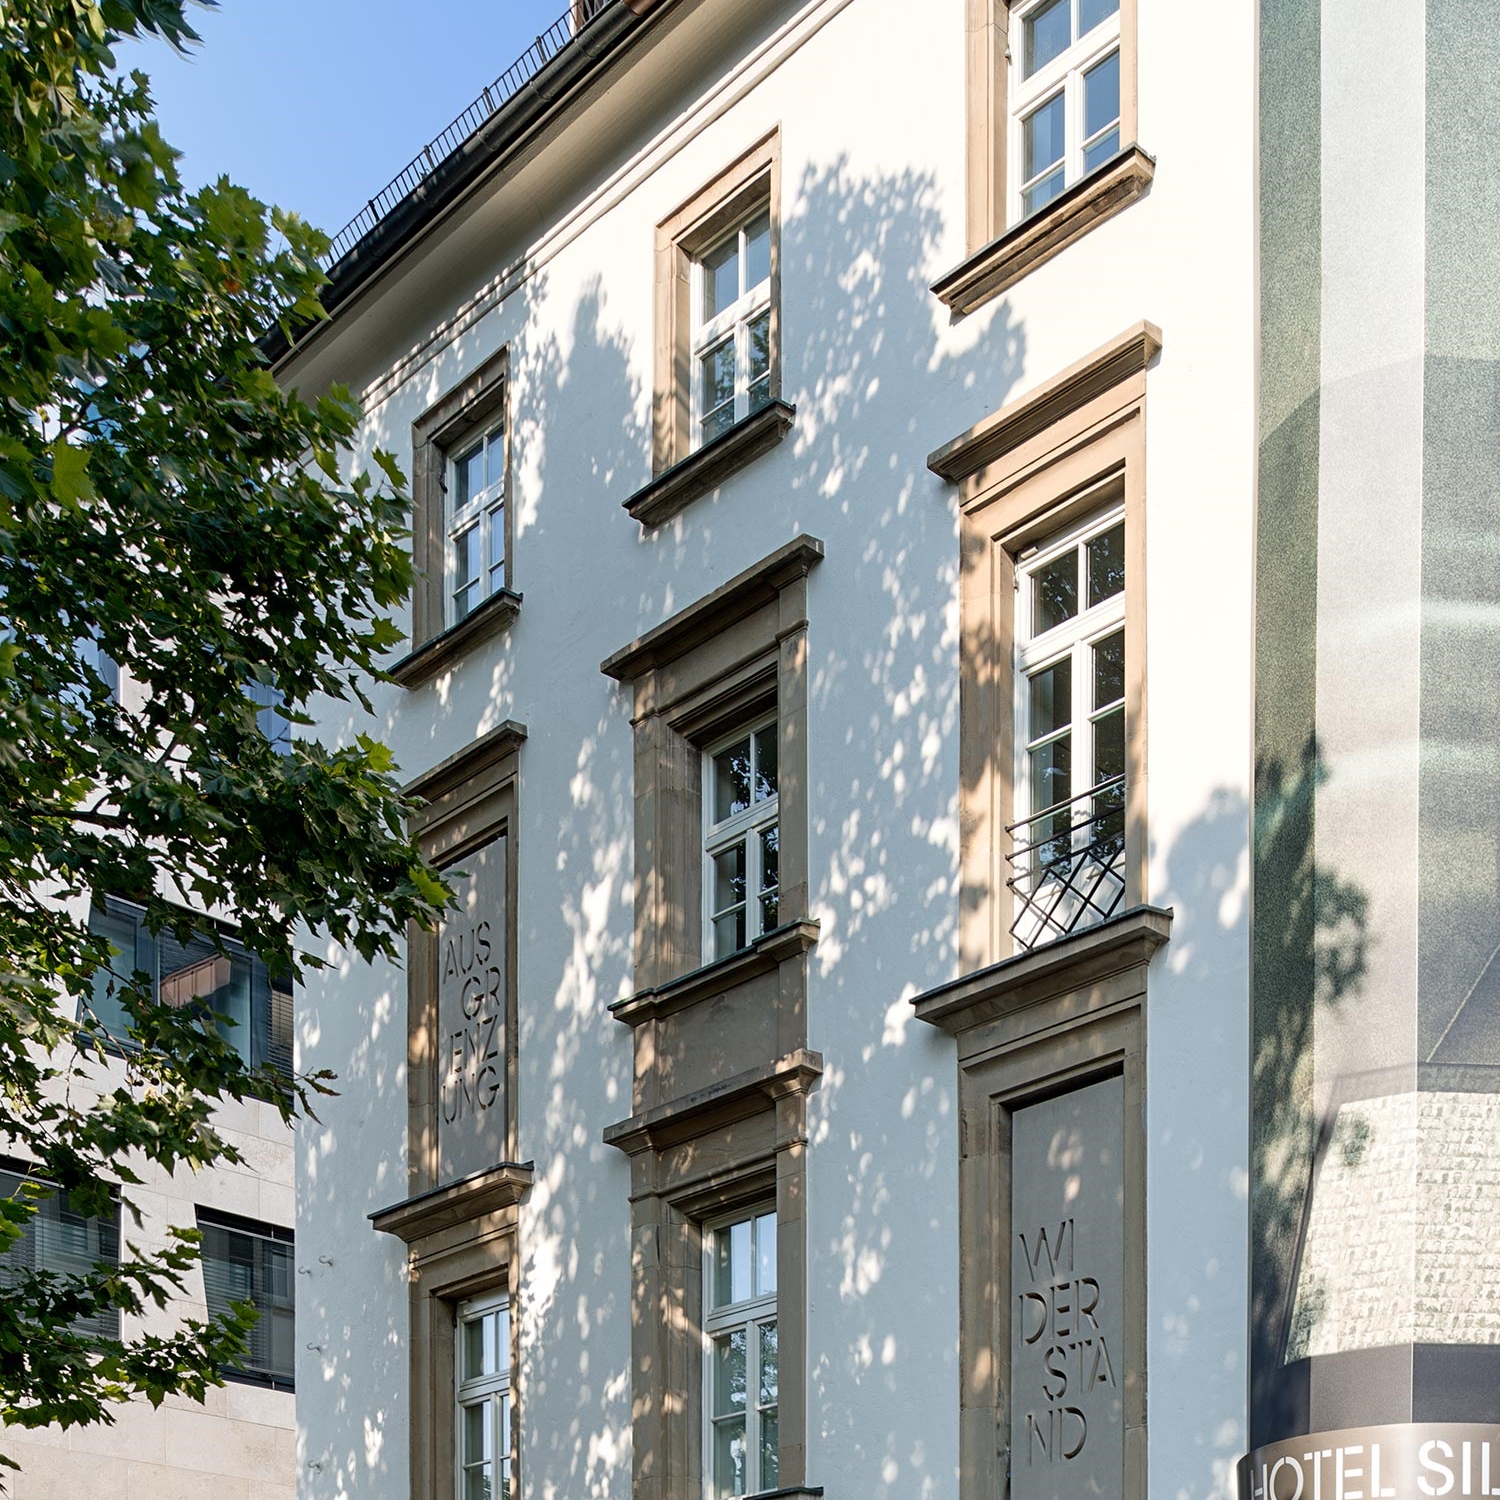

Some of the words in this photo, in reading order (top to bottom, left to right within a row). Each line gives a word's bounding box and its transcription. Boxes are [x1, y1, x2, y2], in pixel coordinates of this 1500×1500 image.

[443, 921, 491, 984] AUS
[461, 966, 500, 1021] GR
[450, 1014, 498, 1076] ENZ
[442, 1065, 500, 1125] UNG
[1018, 1218, 1074, 1282] WI
[1018, 1277, 1100, 1348] DER
[1042, 1336, 1117, 1401] STA
[1026, 1406, 1088, 1467] ND
